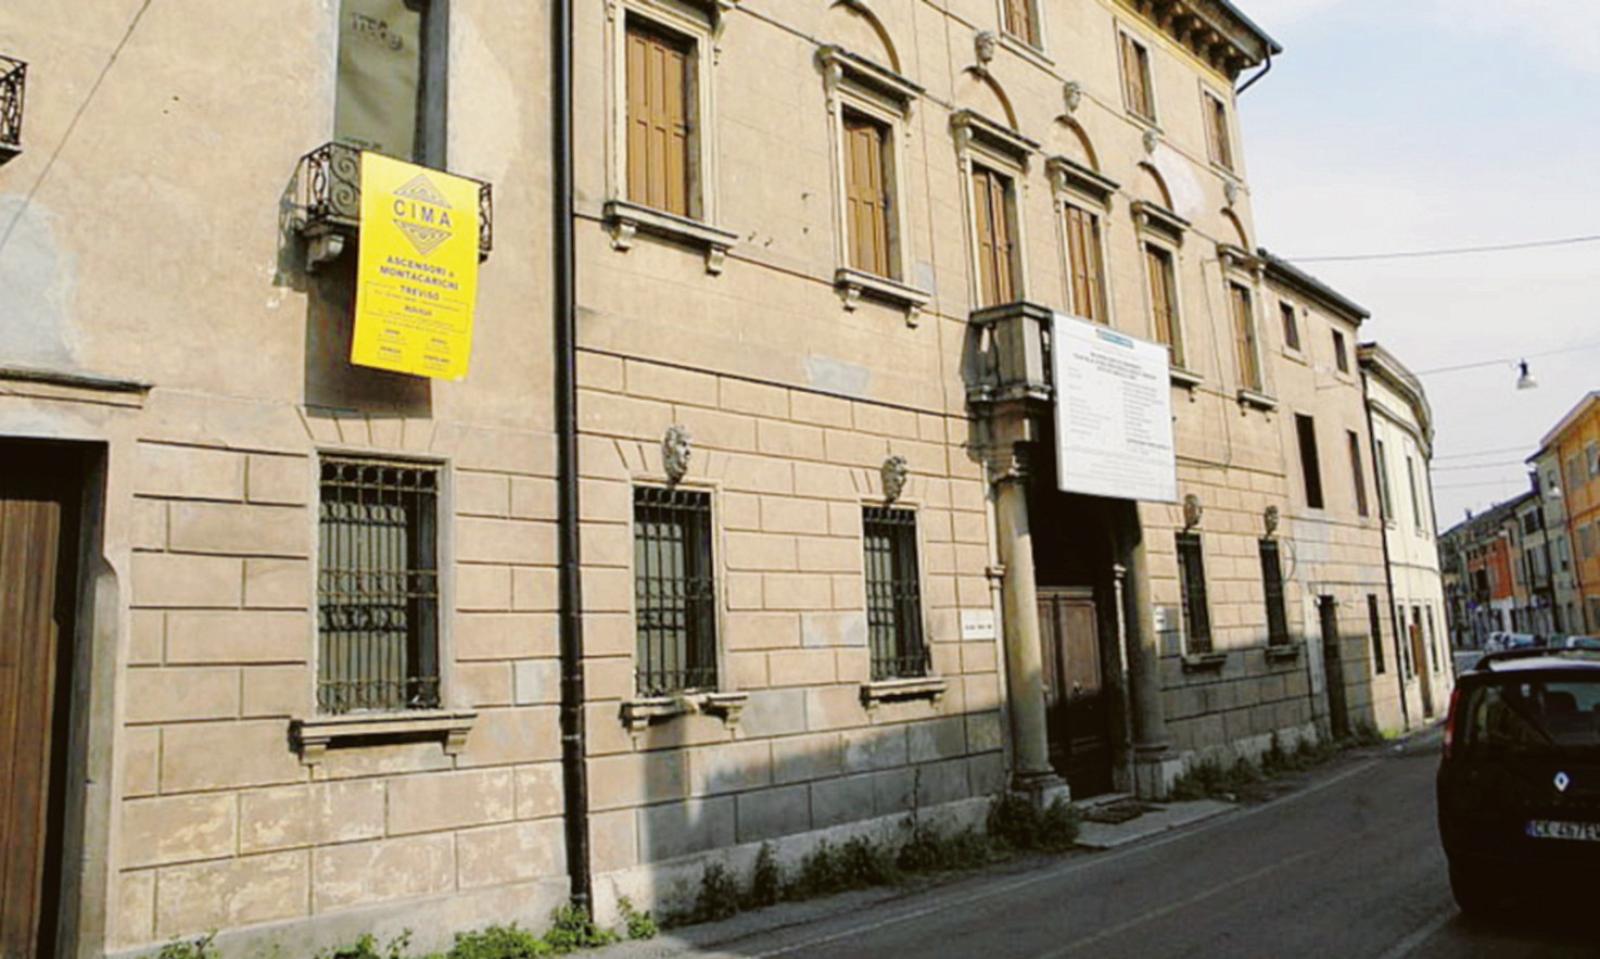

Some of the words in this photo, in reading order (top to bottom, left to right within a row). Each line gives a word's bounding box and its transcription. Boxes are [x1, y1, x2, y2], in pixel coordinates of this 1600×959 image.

[393, 199, 452, 227] CIMA
[379, 265, 459, 290] MONTACARICHI
[400, 285, 440, 301] TREVISO
